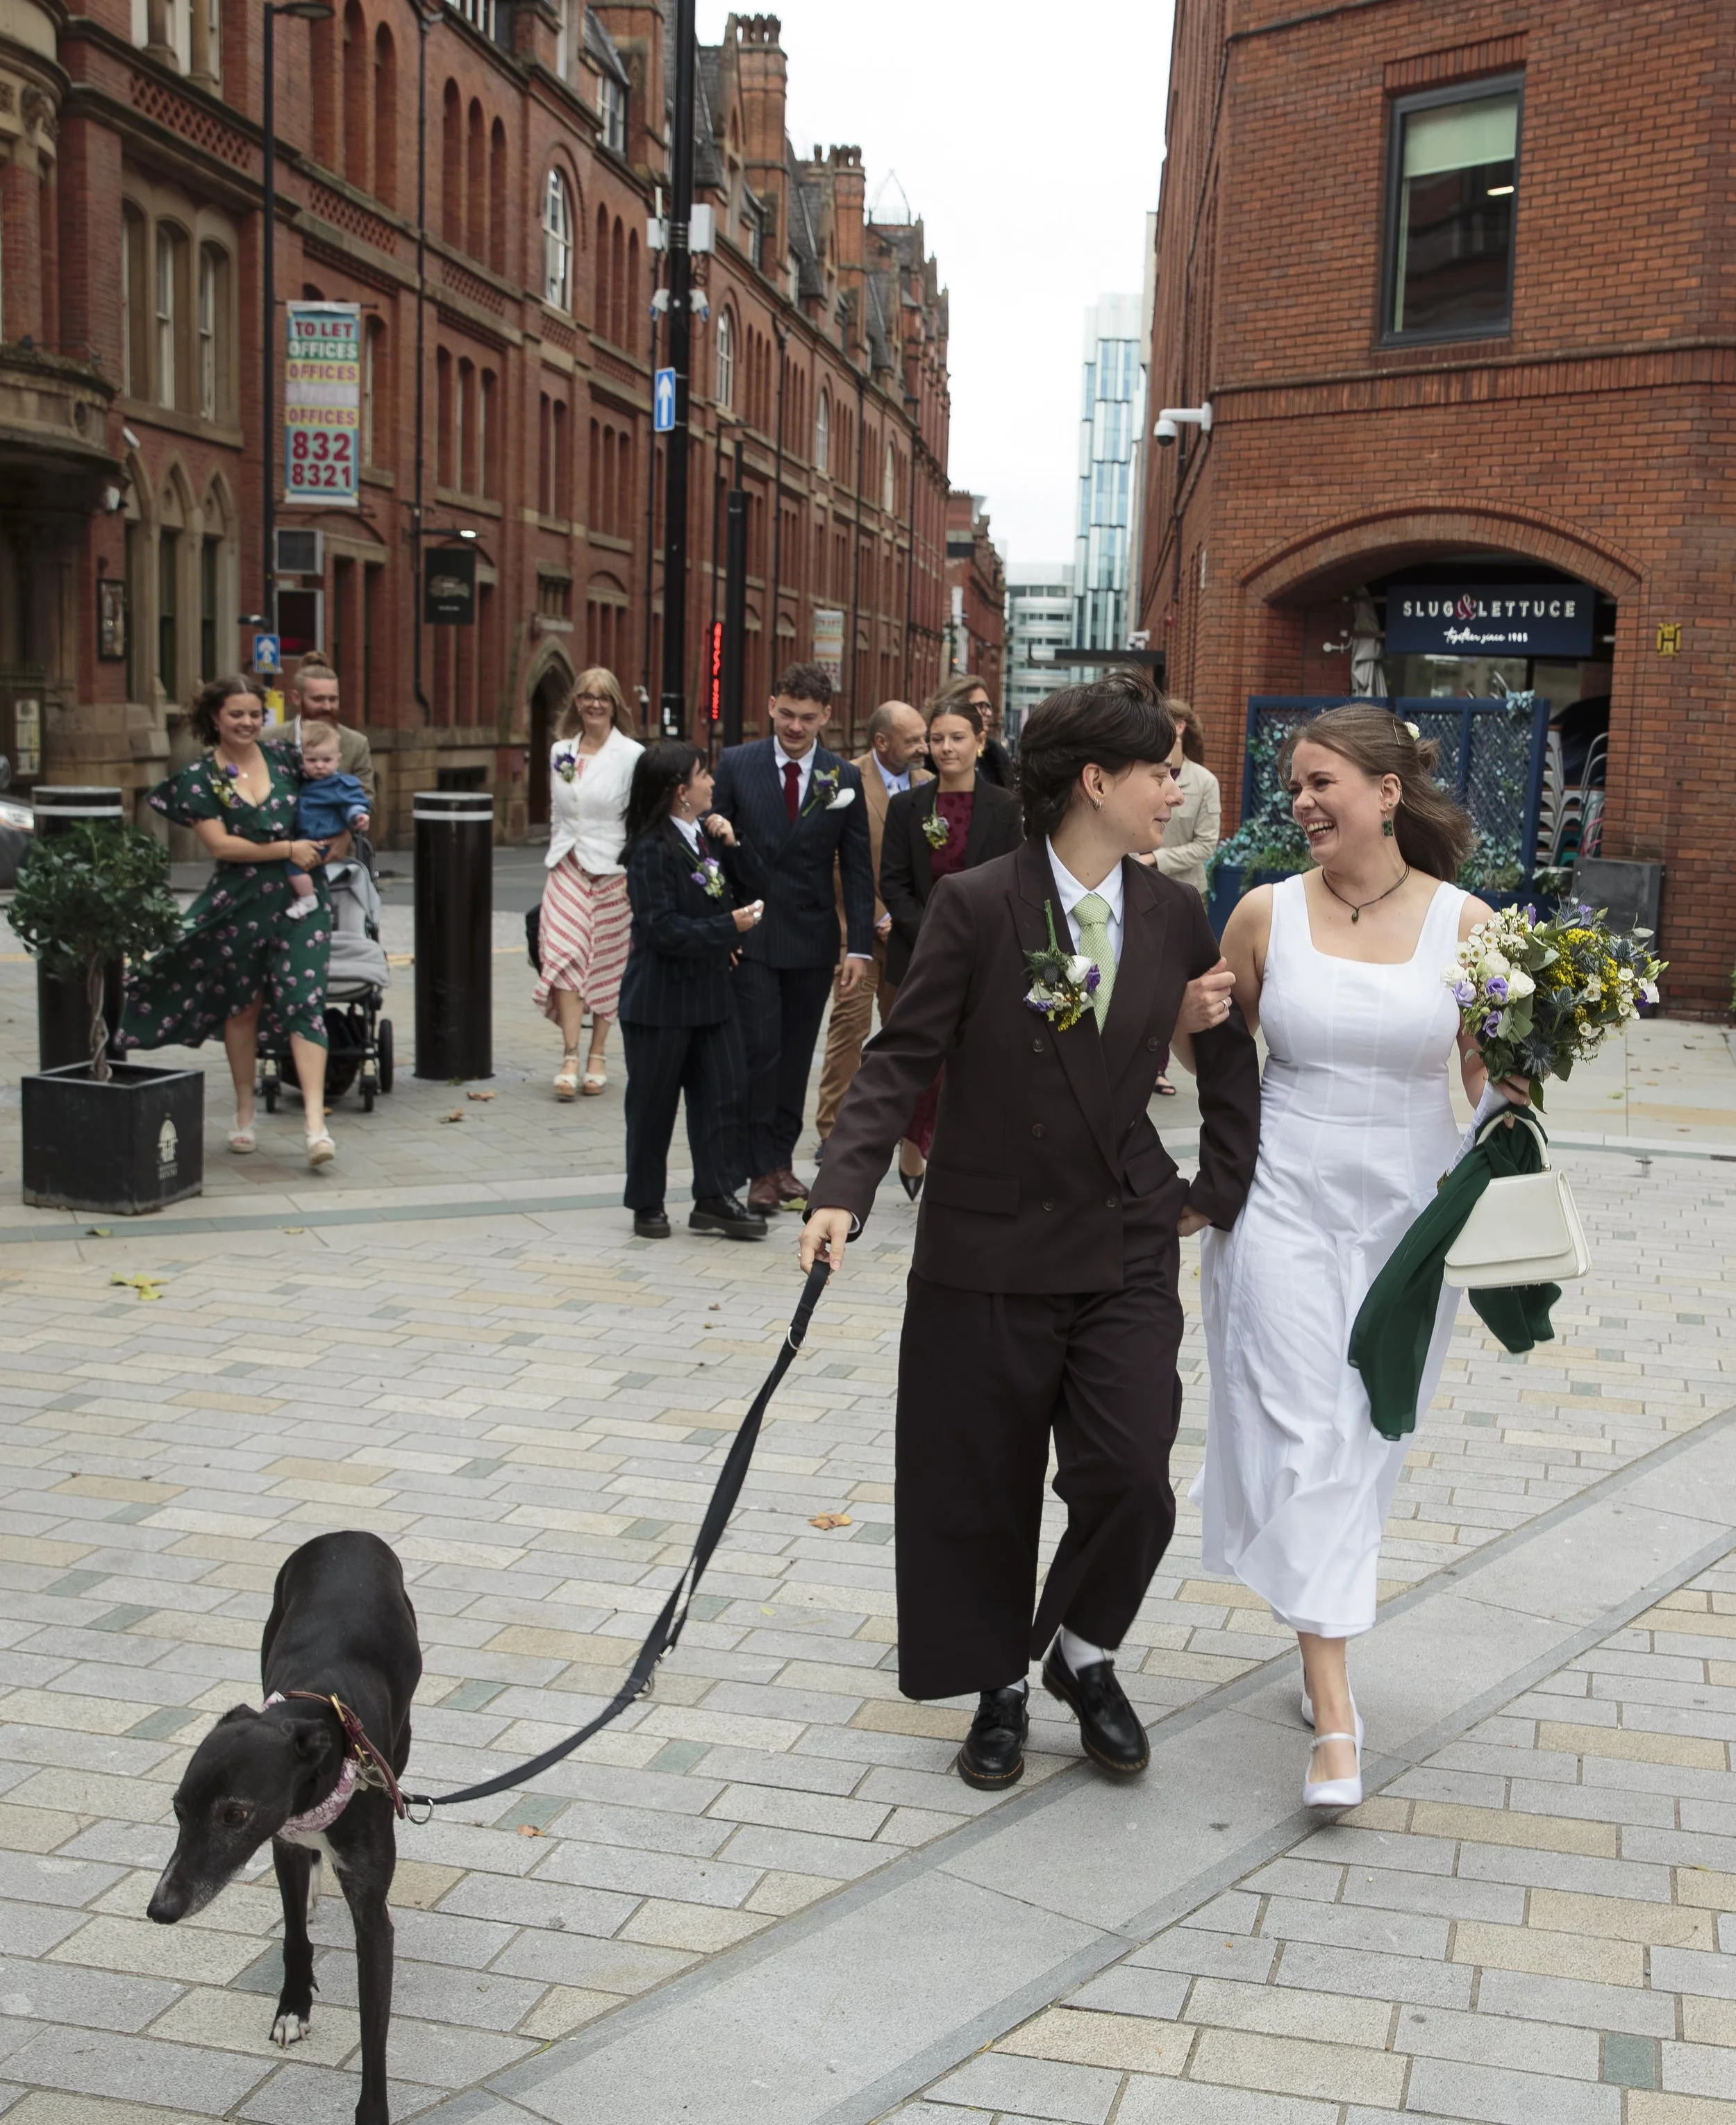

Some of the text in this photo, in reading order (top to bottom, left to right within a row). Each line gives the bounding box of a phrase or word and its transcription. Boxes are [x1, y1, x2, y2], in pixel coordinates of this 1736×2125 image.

[295, 322, 353, 338] TO LET
[288, 341, 358, 359] OFFICES
[289, 364, 356, 381] OFFICES
[288, 408, 356, 426] OFFICES
[292, 431, 351, 462] 832
[292, 464, 351, 488] 8321
[1508, 632, 1528, 642] 1985
